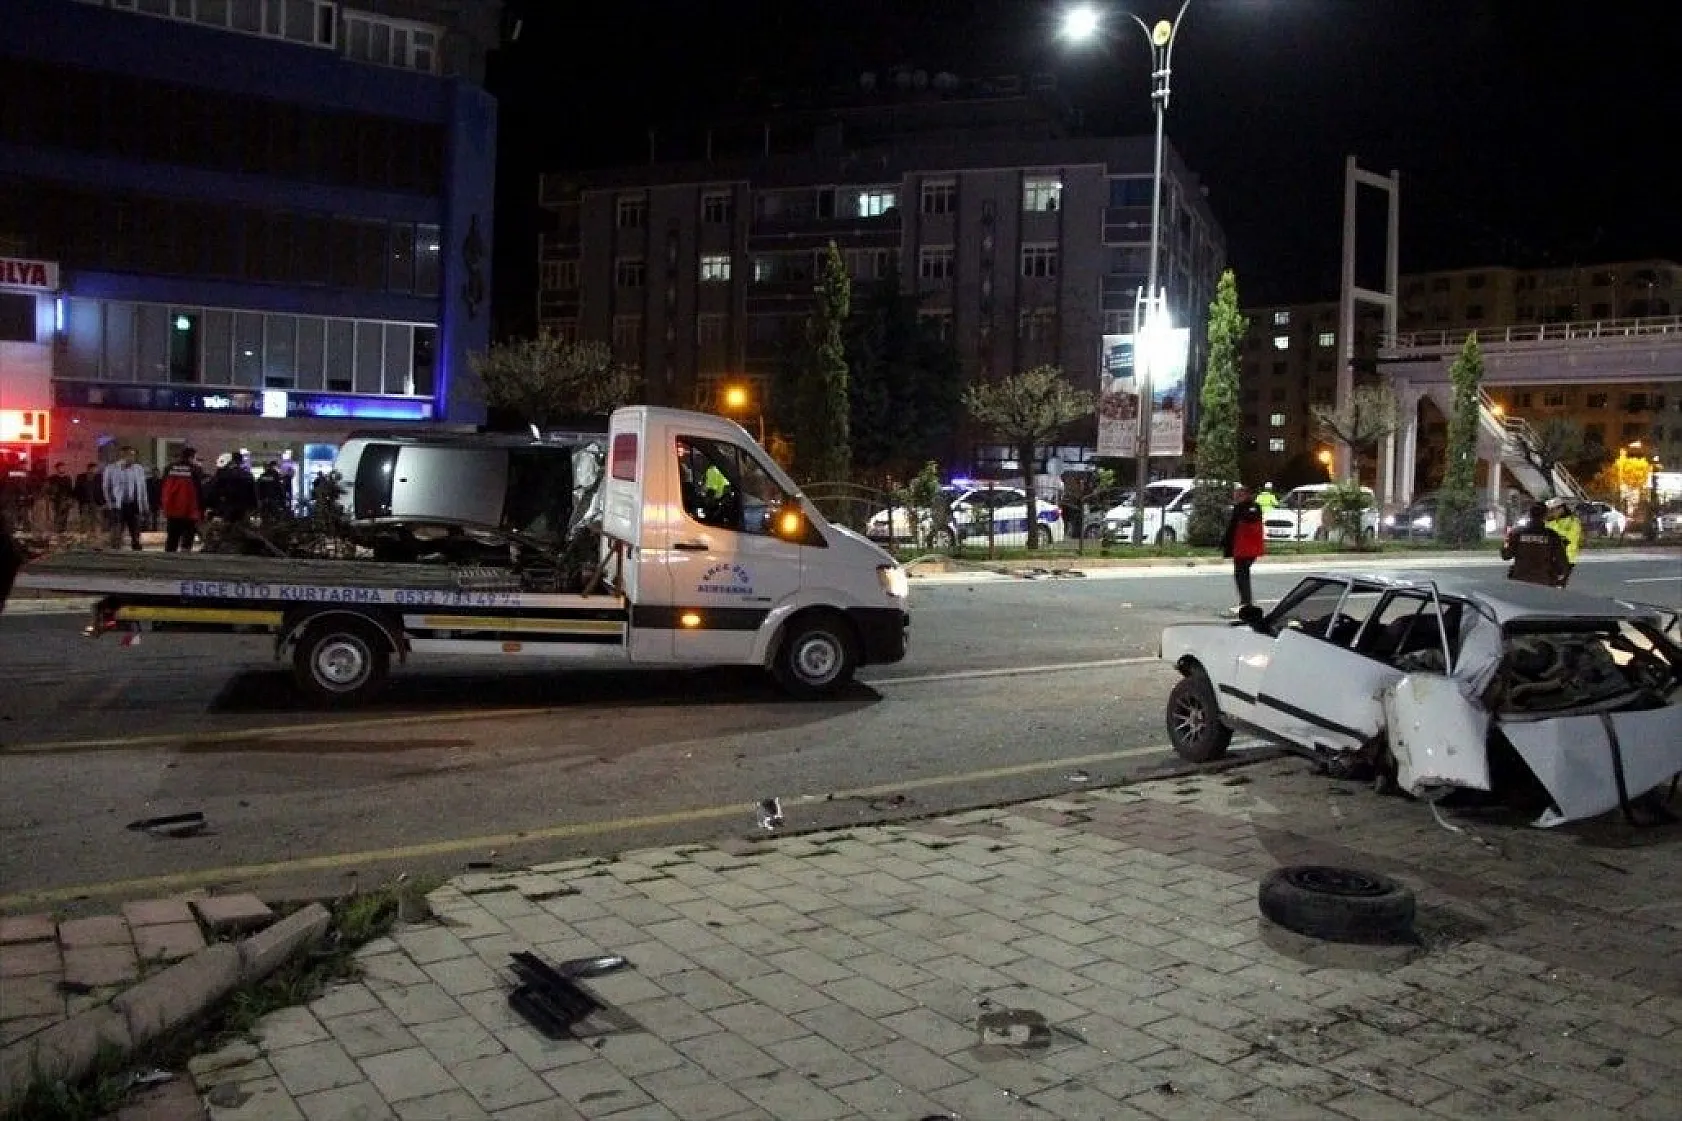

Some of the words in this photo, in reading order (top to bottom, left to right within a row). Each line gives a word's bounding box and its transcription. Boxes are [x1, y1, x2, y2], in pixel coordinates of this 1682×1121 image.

[180, 582, 228, 598] ERCE
[235, 584, 271, 599] OTO
[279, 586, 382, 603] KURTARMA
